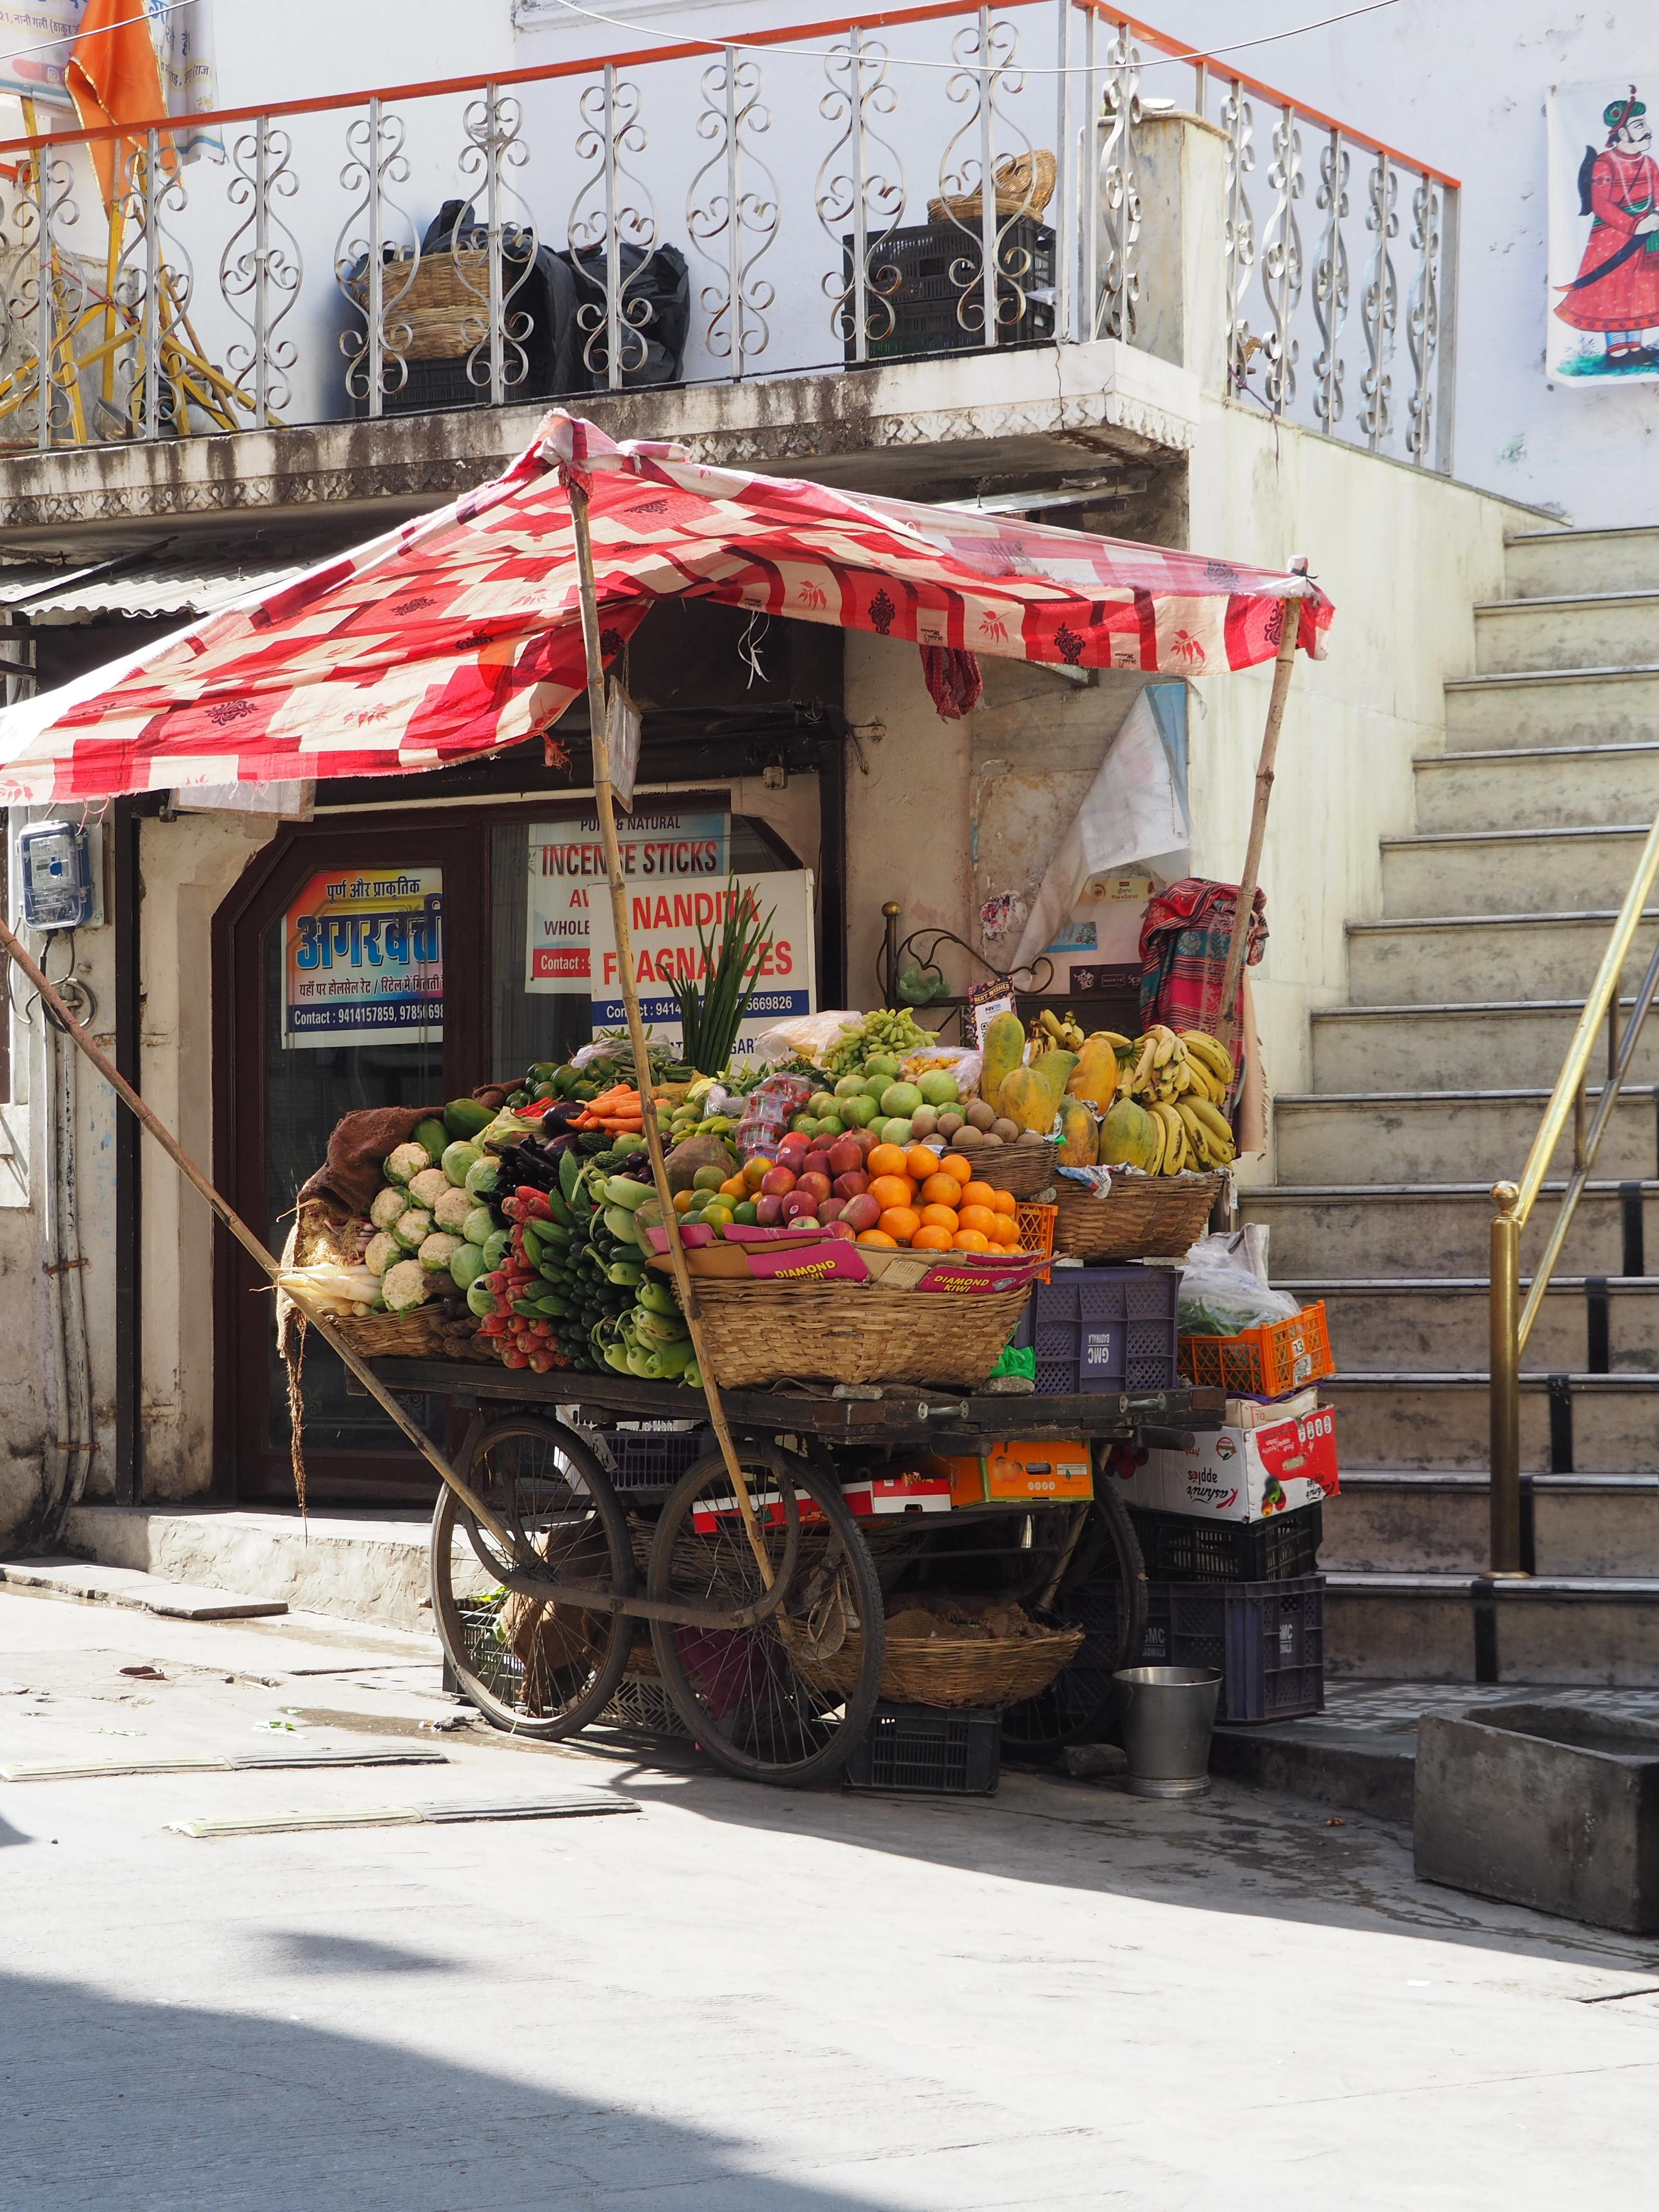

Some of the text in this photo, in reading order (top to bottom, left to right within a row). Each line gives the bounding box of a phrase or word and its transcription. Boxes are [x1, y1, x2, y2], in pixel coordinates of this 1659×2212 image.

[627, 816, 681, 830] NATURAL
[643, 840, 719, 875] STICKS
[349, 878, 371, 898] और
[541, 955, 579, 970] Contact
[316, 983, 327, 995] पर
[328, 978, 359, 995] होलसेल
[360, 977, 372, 993] रेट
[403, 975, 413, 991] में
[974, 983, 1010, 1002] BEST WISHES
[295, 1010, 330, 1025] Contact
[774, 1259, 837, 1279] DIAMOND
[934, 1274, 990, 1287] DIAMOND
[943, 1283, 972, 1293] KIWI
[1088, 1347, 1109, 1364] GMC
[1188, 1467, 1217, 1486] apples
[1186, 1486, 1238, 1509] Kashmir
